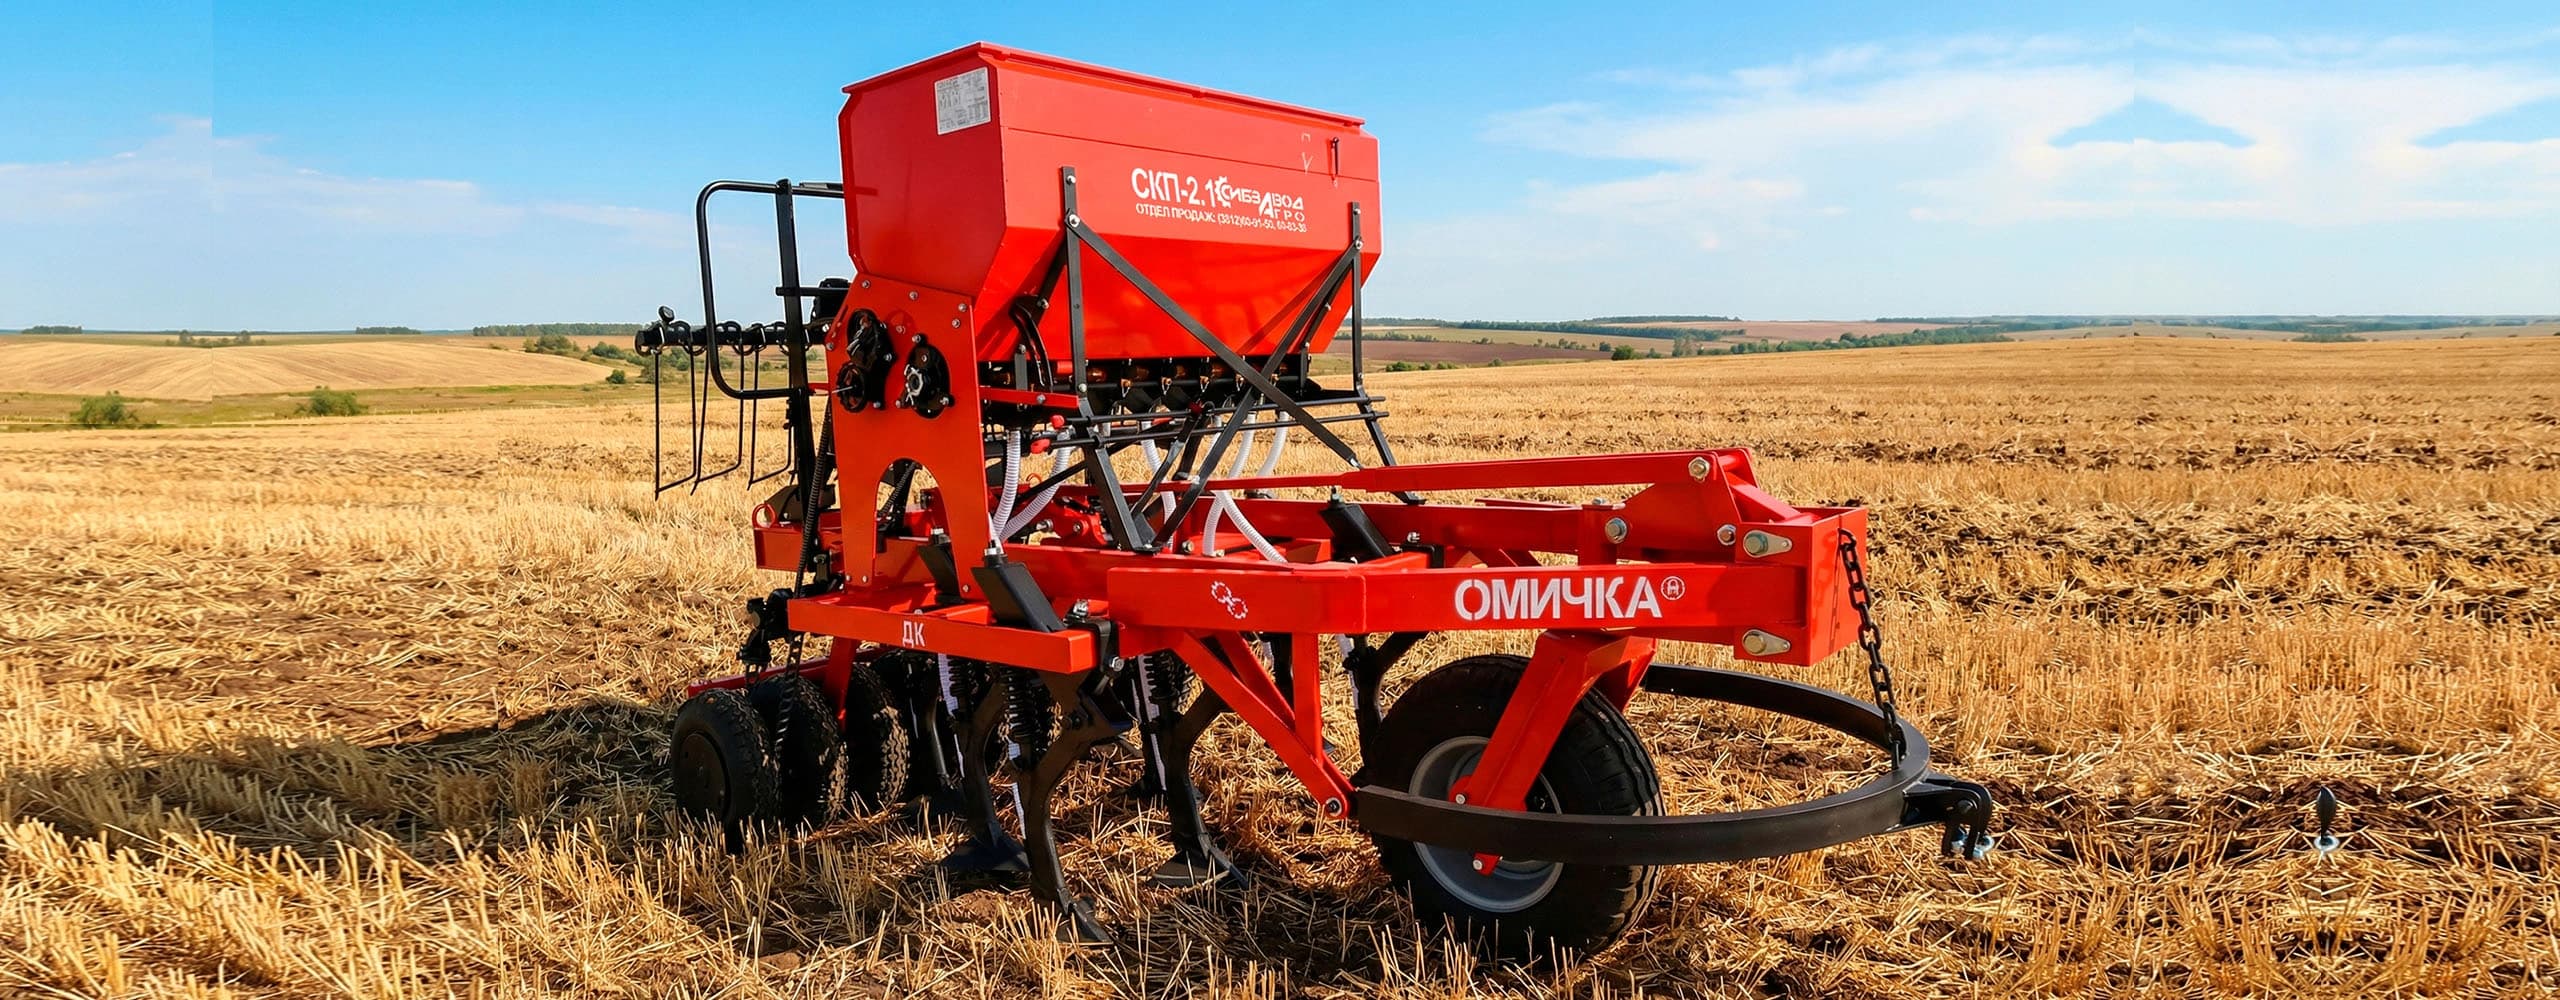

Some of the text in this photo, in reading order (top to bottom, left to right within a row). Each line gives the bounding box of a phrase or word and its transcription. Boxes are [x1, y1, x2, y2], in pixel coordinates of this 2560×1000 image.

[1131, 167, 1215, 208] СКП-2.1
[1135, 202, 1170, 218] ОТДЕЛ
[1171, 207, 1216, 223] ПРОДАЖ:
[1454, 576, 1663, 621] ОМИЧКА
[902, 620, 926, 649] ДК
